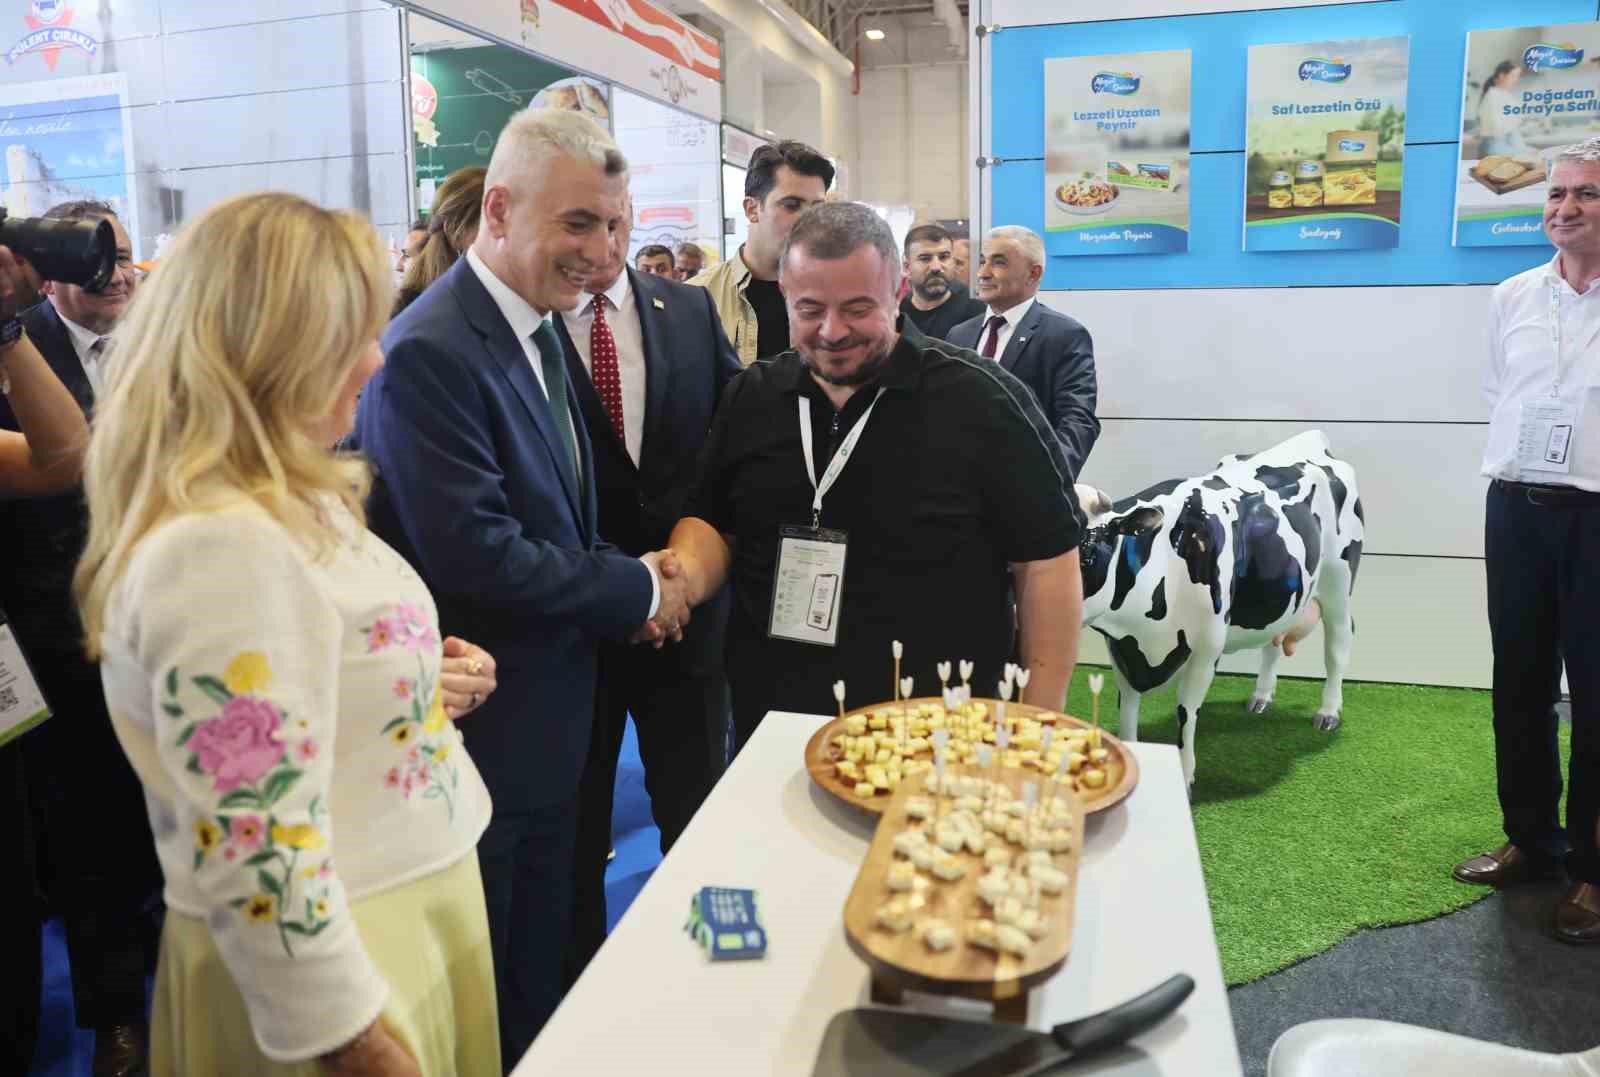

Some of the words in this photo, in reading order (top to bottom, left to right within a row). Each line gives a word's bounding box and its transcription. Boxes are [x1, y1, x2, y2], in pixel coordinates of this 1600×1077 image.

[1522, 89, 1595, 104] Doğadan
[1271, 103, 1294, 115] Saf
[1296, 101, 1352, 114] Lezzetin
[1354, 97, 1382, 111] Özü
[1503, 103, 1565, 116] Sofraya
[1073, 108, 1115, 121] Lezzeti
[1117, 107, 1161, 118] Uzatan
[1096, 119, 1137, 132] Peynir
